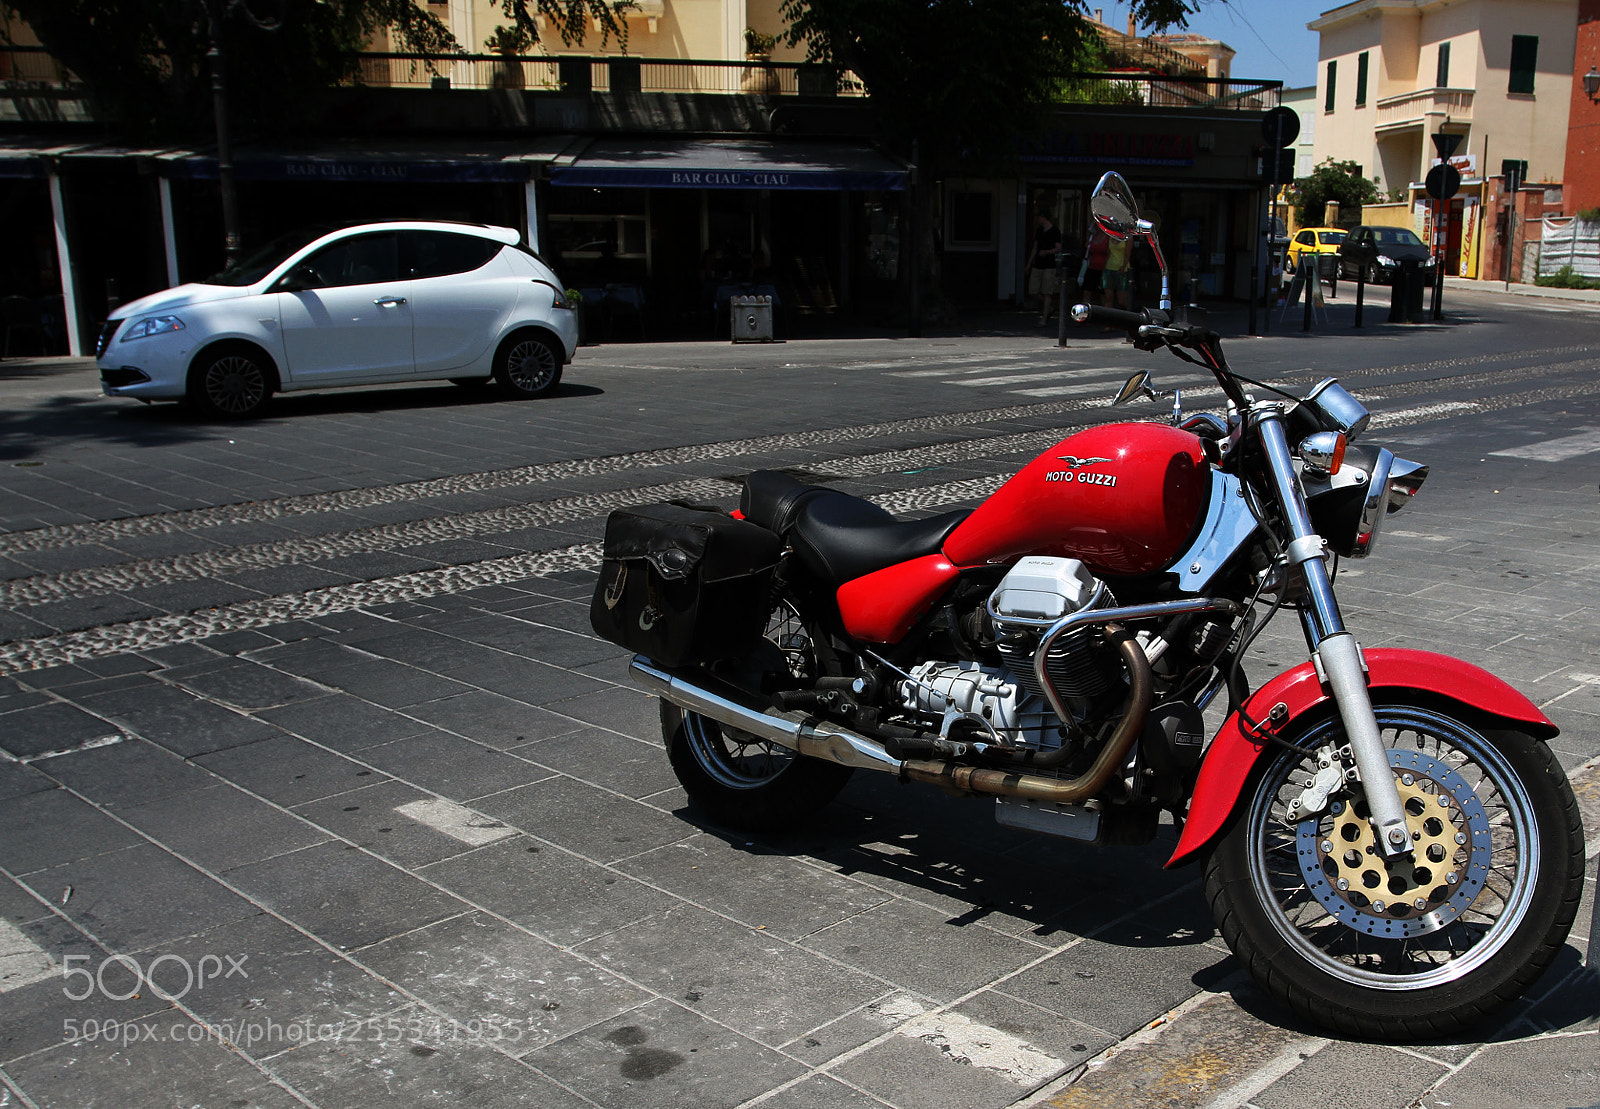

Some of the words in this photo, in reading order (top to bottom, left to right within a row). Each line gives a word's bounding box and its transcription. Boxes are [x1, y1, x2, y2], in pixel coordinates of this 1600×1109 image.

[1090, 132, 1194, 157] BELLEZZA
[286, 164, 317, 176] BAR
[320, 164, 358, 177] CIAU
[370, 165, 408, 178] CIAU
[671, 172, 702, 184] BAR
[704, 173, 742, 185] CIAU
[752, 174, 790, 186] CIAU
[1045, 471, 1074, 482] MOTO
[1077, 472, 1117, 487] GUZZI
